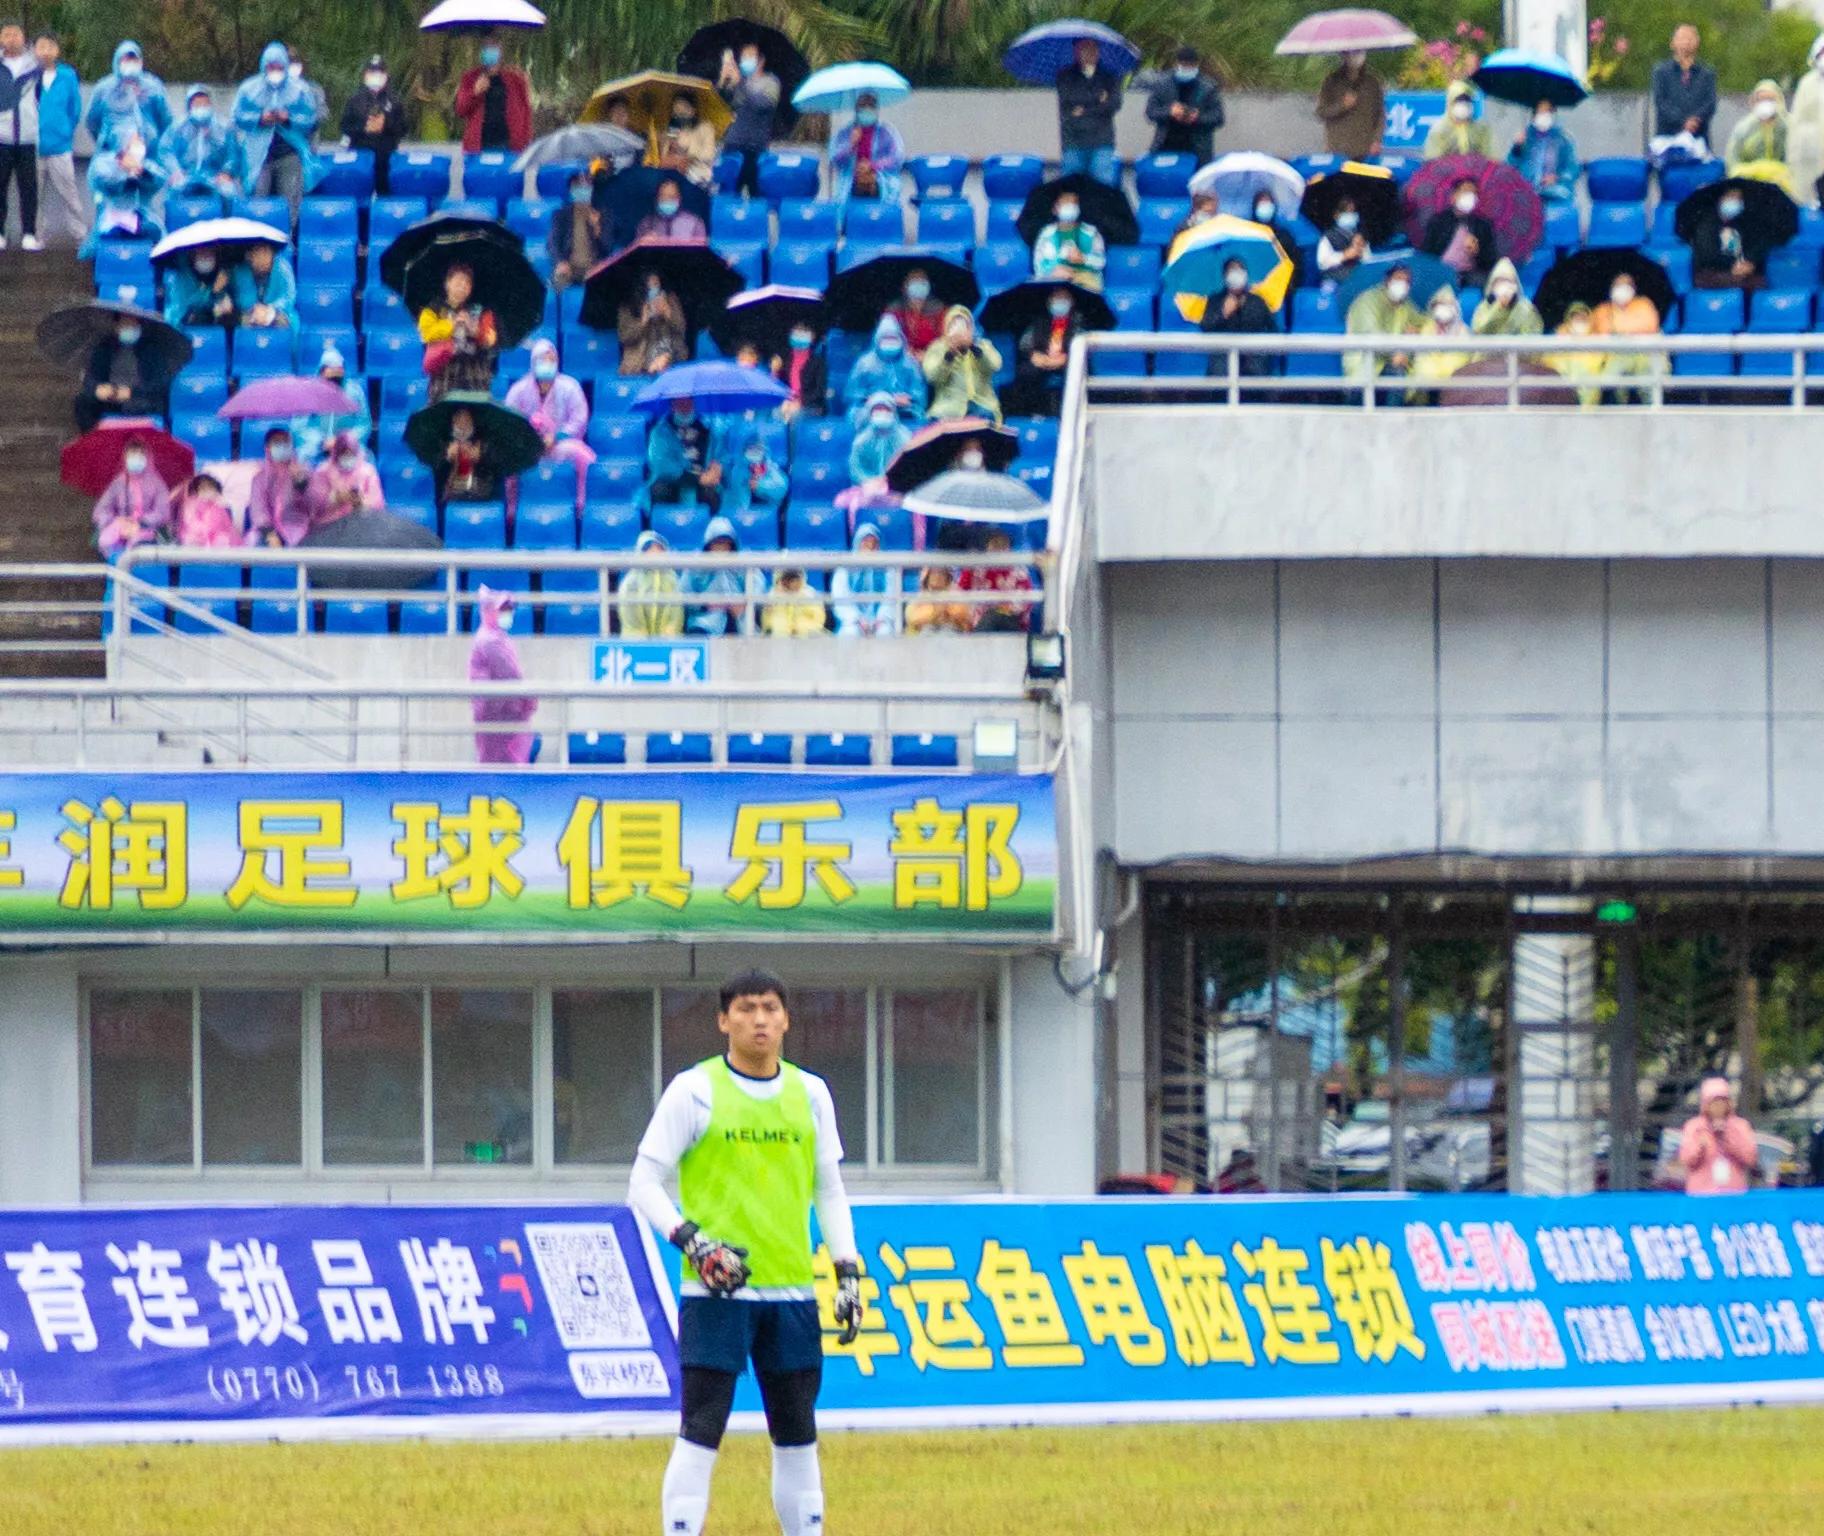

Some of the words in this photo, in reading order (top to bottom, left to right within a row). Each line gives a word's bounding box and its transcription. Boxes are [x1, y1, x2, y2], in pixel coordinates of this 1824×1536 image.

[1385, 103, 1437, 141] 北一
[600, 646, 702, 688] 北一区
[724, 1129, 789, 1142] KELME
[0, 1236, 497, 1353] 育连锁品牌
[815, 1236, 1425, 1376] 幸运鱼电脑连锁
[207, 1361, 320, 1404] (0770)
[344, 1365, 403, 1398] 767
[426, 1364, 506, 1398] 1388
